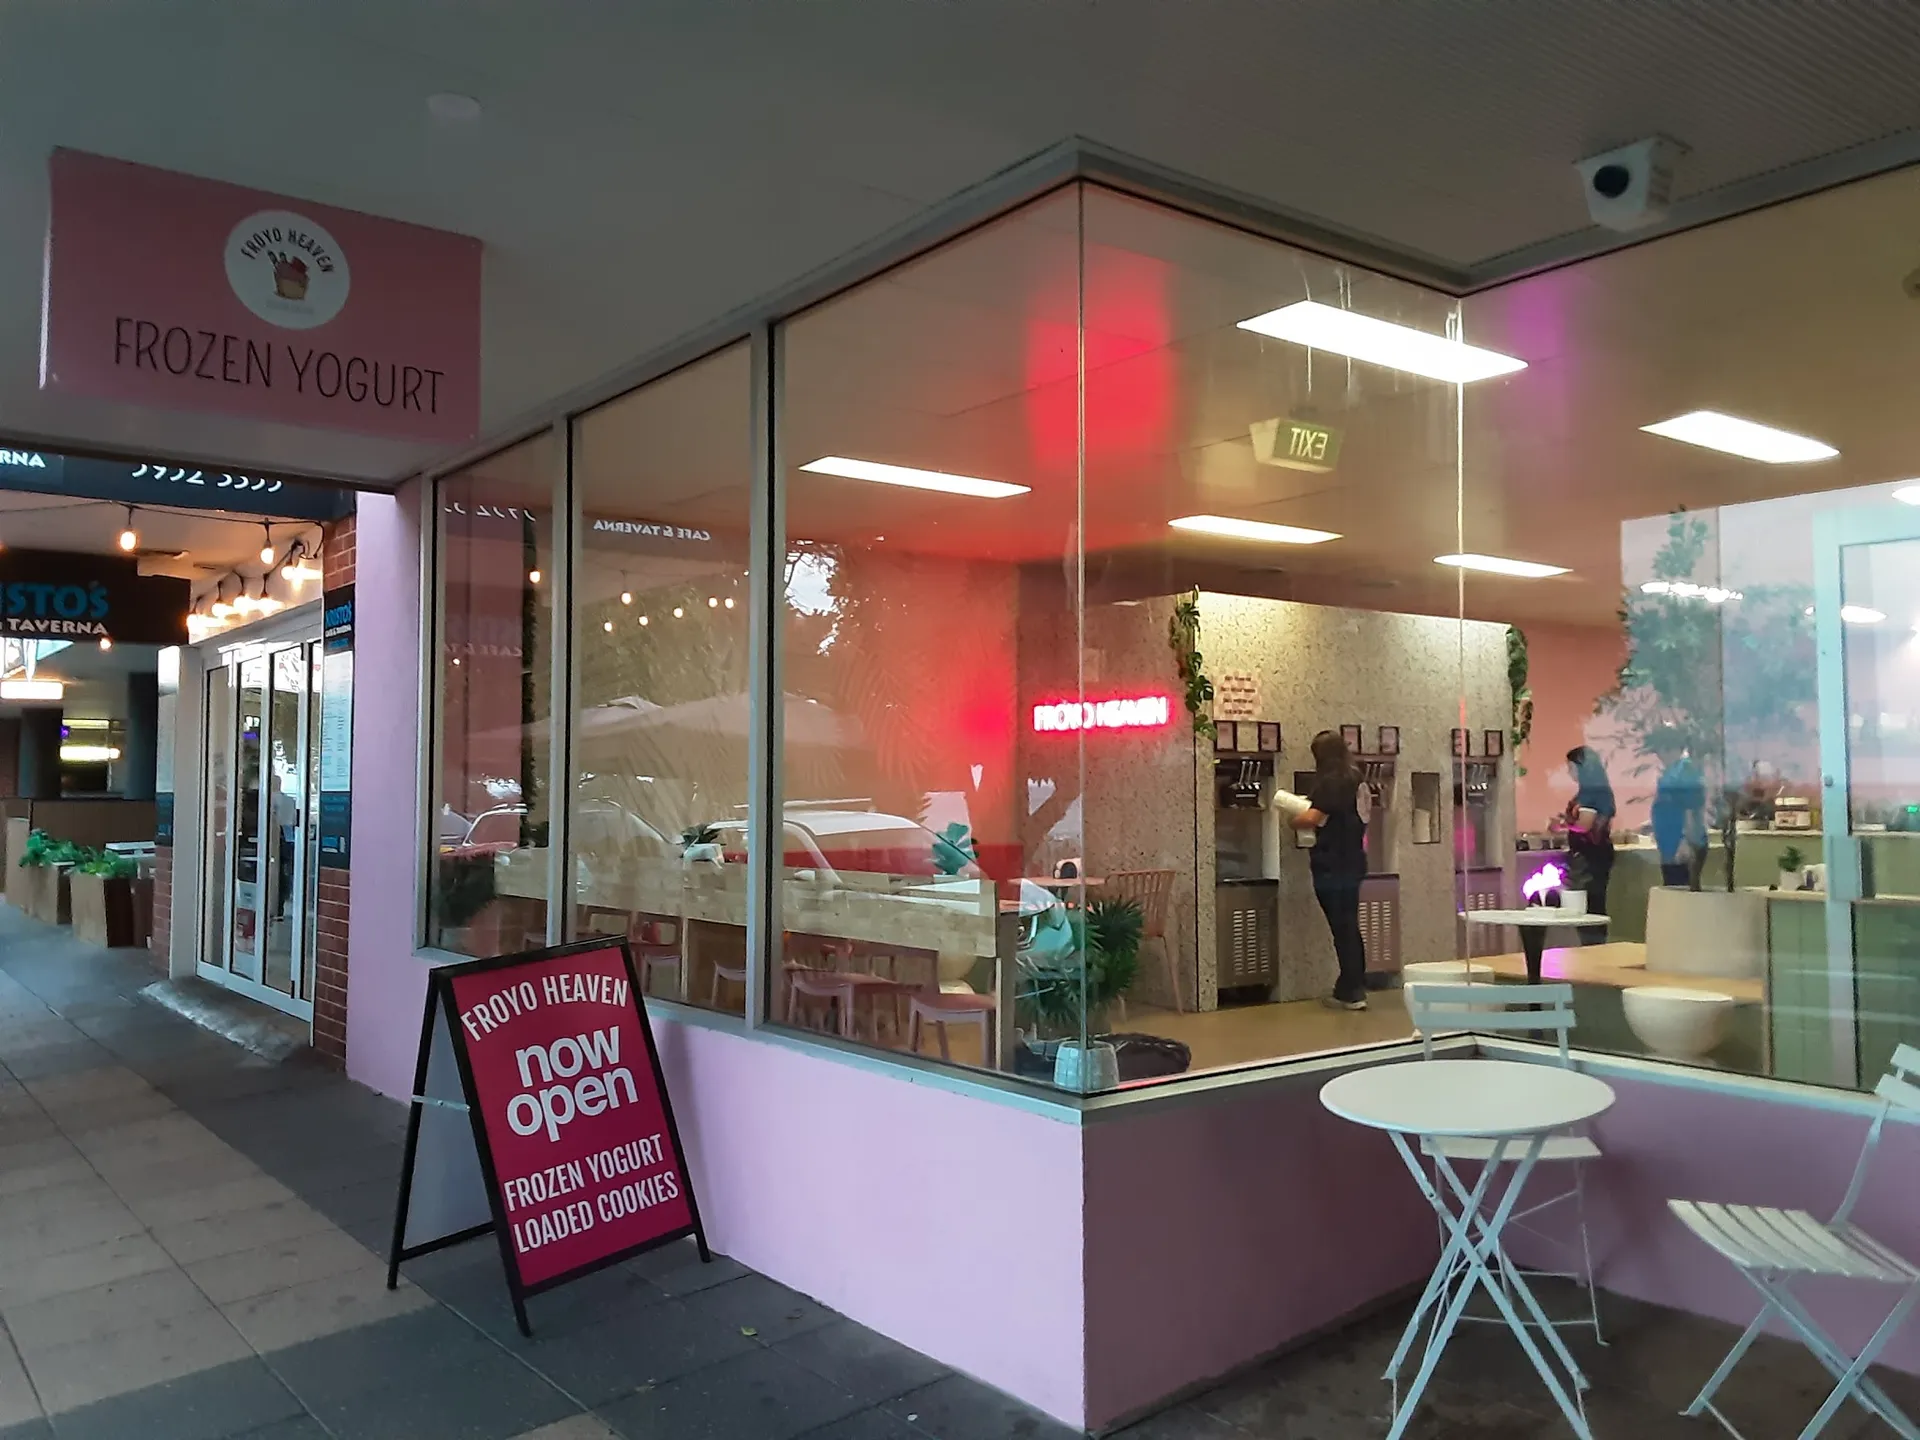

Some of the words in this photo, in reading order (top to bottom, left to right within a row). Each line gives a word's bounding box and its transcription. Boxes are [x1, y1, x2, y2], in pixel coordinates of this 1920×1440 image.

[240, 227, 282, 260] FROYO
[287, 228, 335, 272] HEAVEN
[114, 317, 271, 388] FROZEN
[287, 345, 445, 414] YOGURT
[0, 581, 110, 618] STO'S
[6, 617, 109, 635] TAVERNA
[460, 980, 538, 1042] FROYO
[541, 973, 628, 1008] HEAVEN
[515, 1025, 620, 1088] now
[506, 1067, 639, 1143] open
[504, 1160, 585, 1212] FROZEN
[585, 1133, 665, 1184] YOGURT
[513, 1200, 595, 1254] LOADED
[597, 1170, 680, 1223] COOKIES
